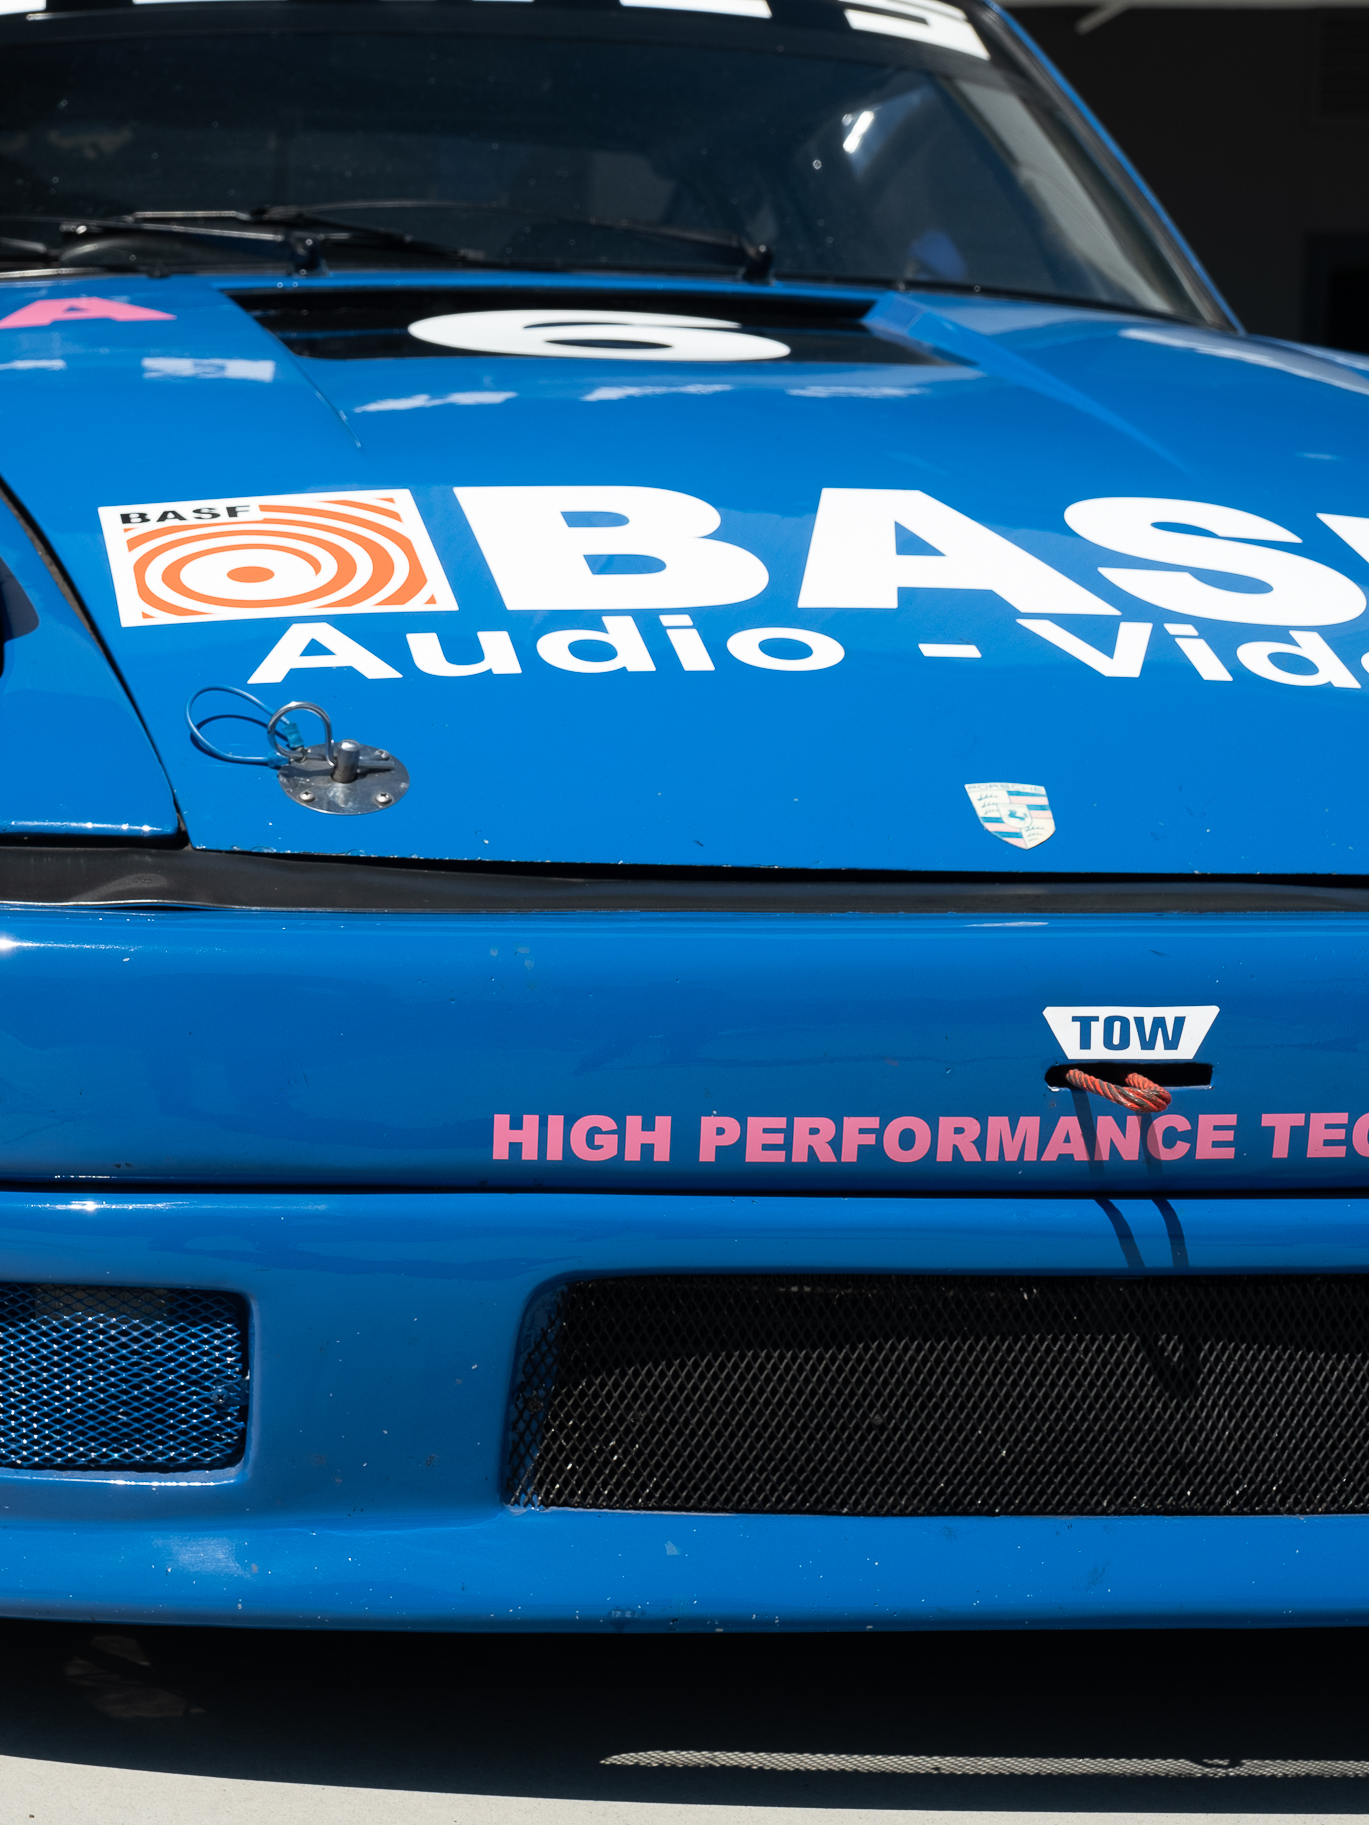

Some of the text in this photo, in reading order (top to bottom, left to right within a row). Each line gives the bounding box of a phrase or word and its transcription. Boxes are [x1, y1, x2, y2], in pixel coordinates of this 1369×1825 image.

[407, 310, 791, 362] 6
[119, 504, 252, 525] BASF
[453, 486, 1369, 627] BAS
[247, 614, 845, 684] Audio
[1016, 618, 1369, 689] Vid
[967, 784, 1044, 794] PORSCHE
[1071, 1015, 1187, 1051] TOW
[492, 1113, 672, 1162] HIGH
[698, 1113, 1238, 1163] PERFORMANCE
